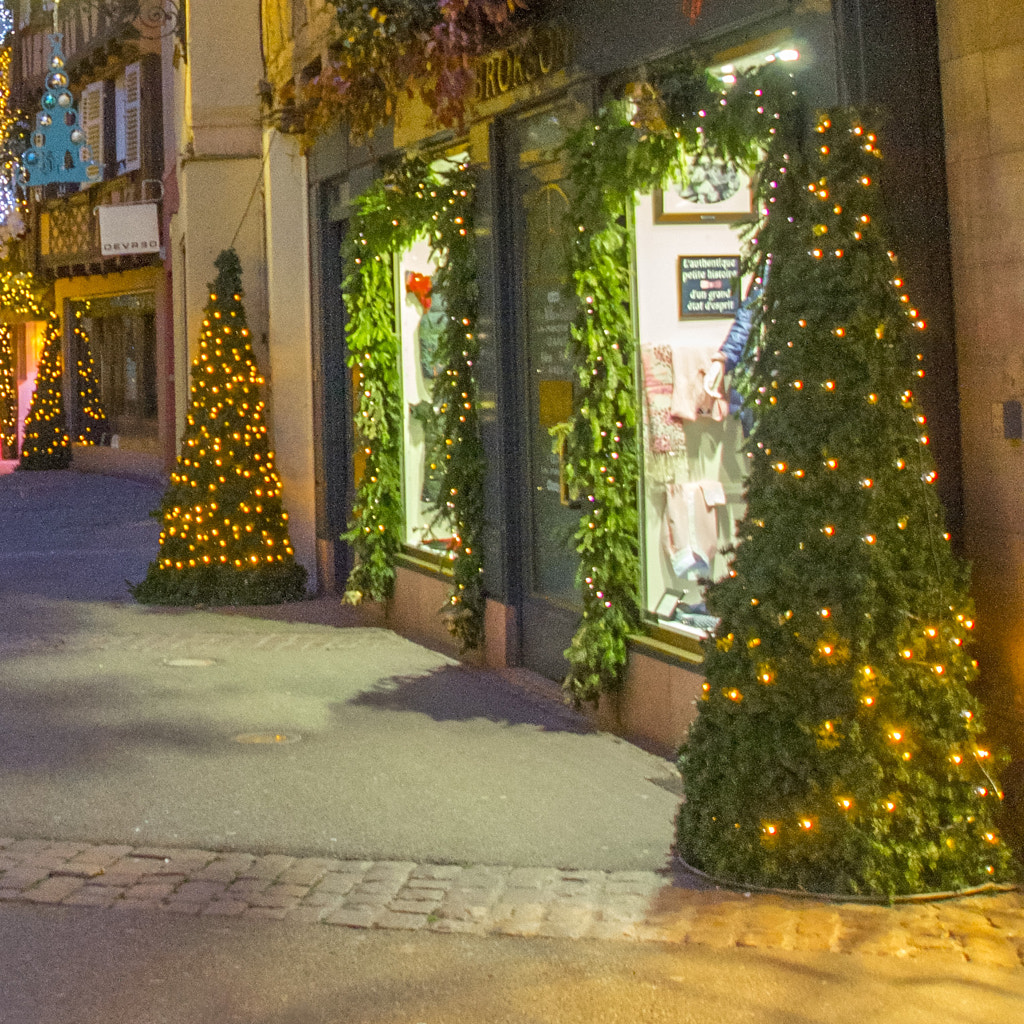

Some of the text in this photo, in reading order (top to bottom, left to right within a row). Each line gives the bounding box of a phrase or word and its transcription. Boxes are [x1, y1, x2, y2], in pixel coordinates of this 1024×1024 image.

[683, 258, 736, 270] L'authentique
[682, 270, 705, 283] petite
[708, 289, 731, 302] grand
